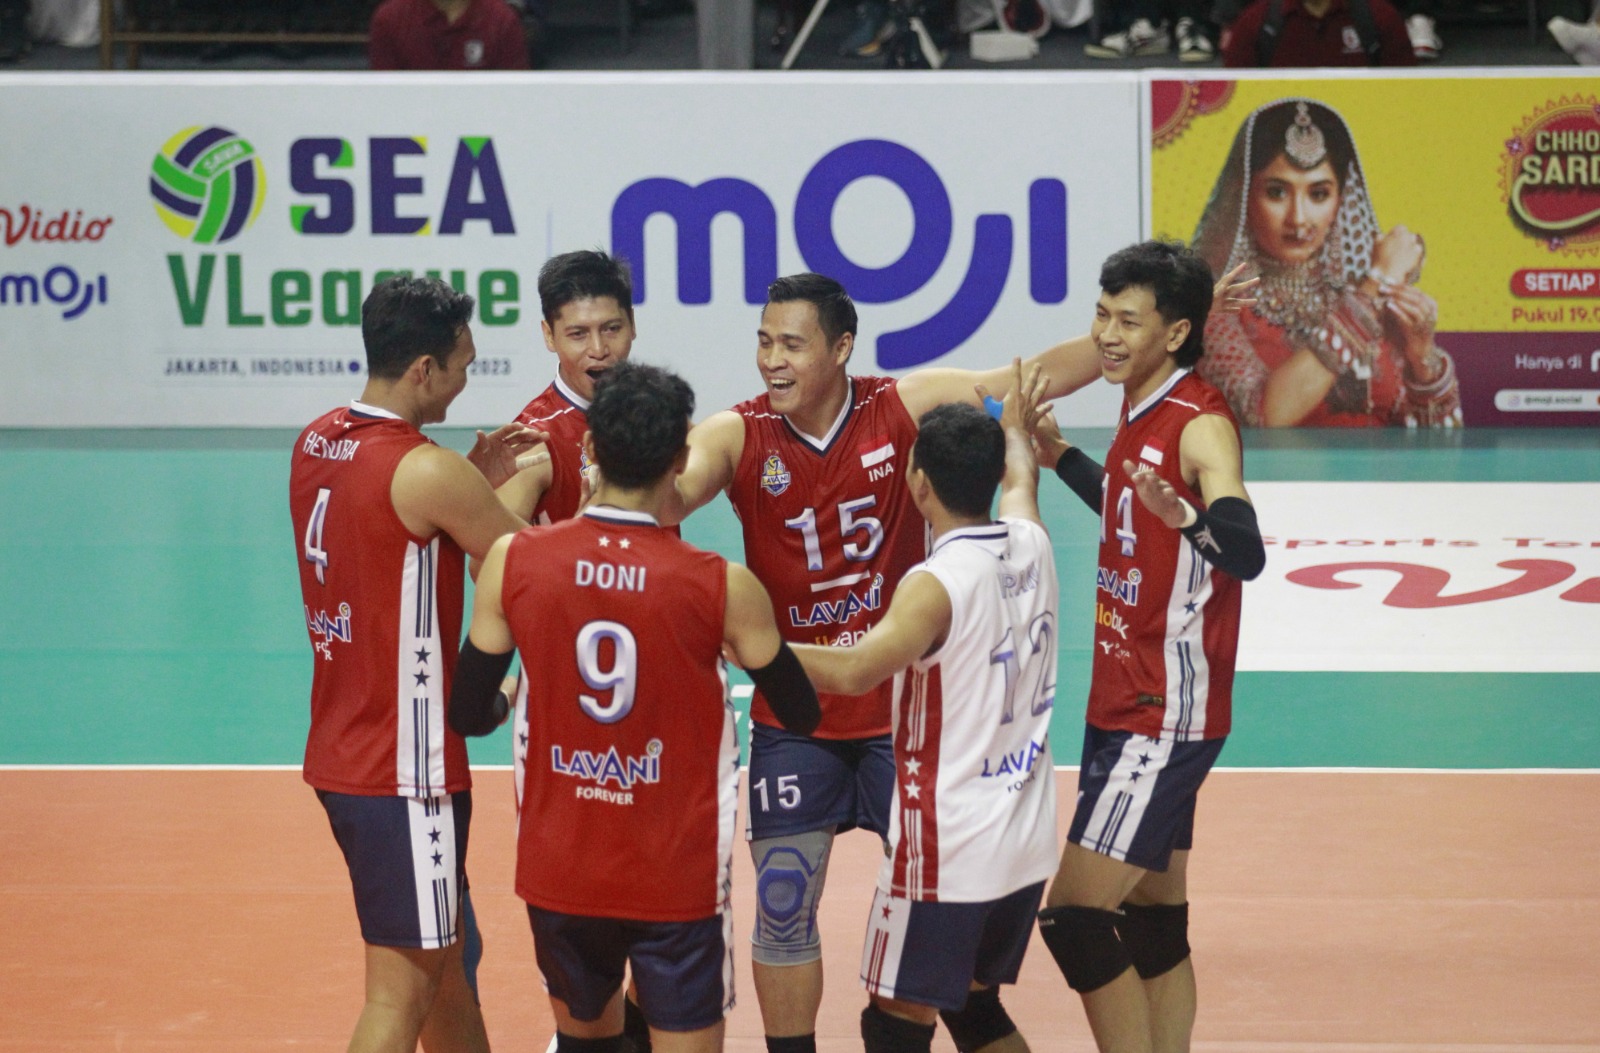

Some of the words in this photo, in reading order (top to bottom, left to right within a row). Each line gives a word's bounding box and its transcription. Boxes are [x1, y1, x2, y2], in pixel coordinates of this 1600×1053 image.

[288, 136, 516, 236] SEA
[0, 205, 113, 246] Vidio
[166, 253, 521, 327] VLeae
[1524, 272, 1596, 292] SETIAP
[1512, 306, 1563, 323] Pukul
[251, 358, 345, 376] INDONESIA
[1515, 354, 1564, 373] Hanya
[1566, 353, 1582, 370] di
[868, 462, 895, 483] INA
[304, 486, 333, 586] 4
[784, 493, 884, 571] 15
[575, 560, 646, 593] DONI
[575, 619, 638, 725] 9
[989, 610, 1057, 726] 12
[575, 786, 635, 806] FOREVER
[753, 774, 802, 813] 15
